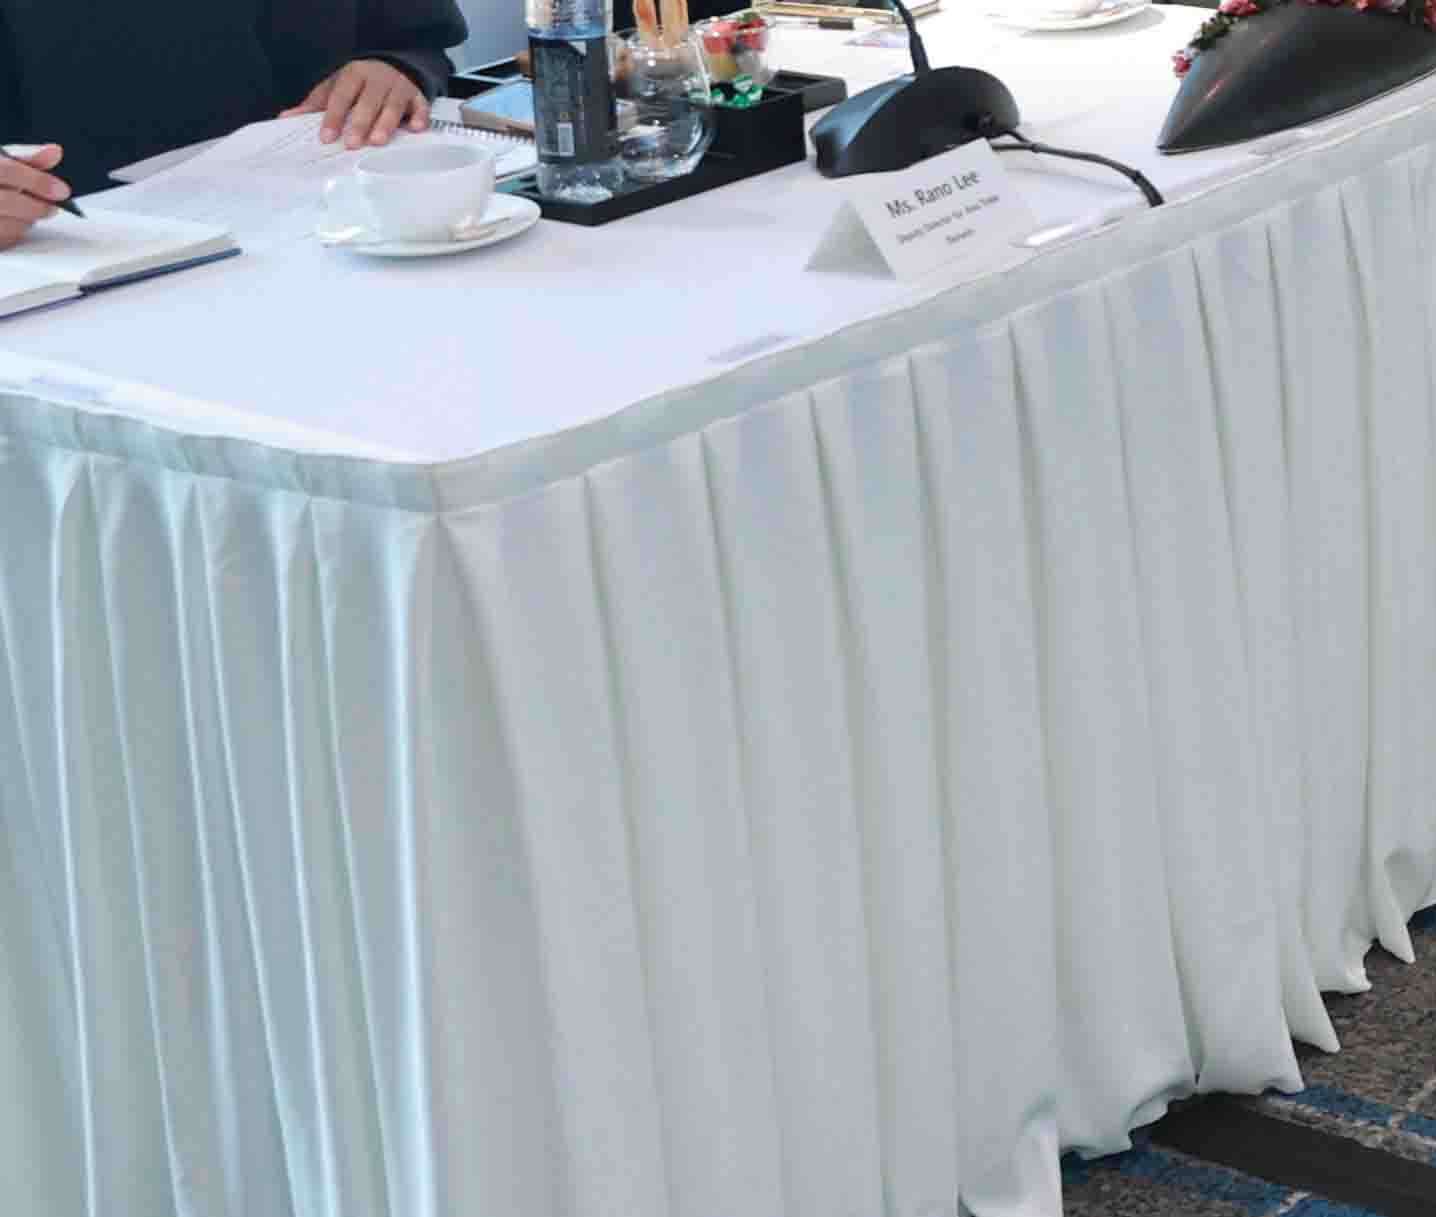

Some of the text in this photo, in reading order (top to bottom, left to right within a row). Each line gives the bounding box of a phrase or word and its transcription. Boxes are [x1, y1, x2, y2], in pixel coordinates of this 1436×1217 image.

[885, 170, 981, 219] Ms. Rano Lee
